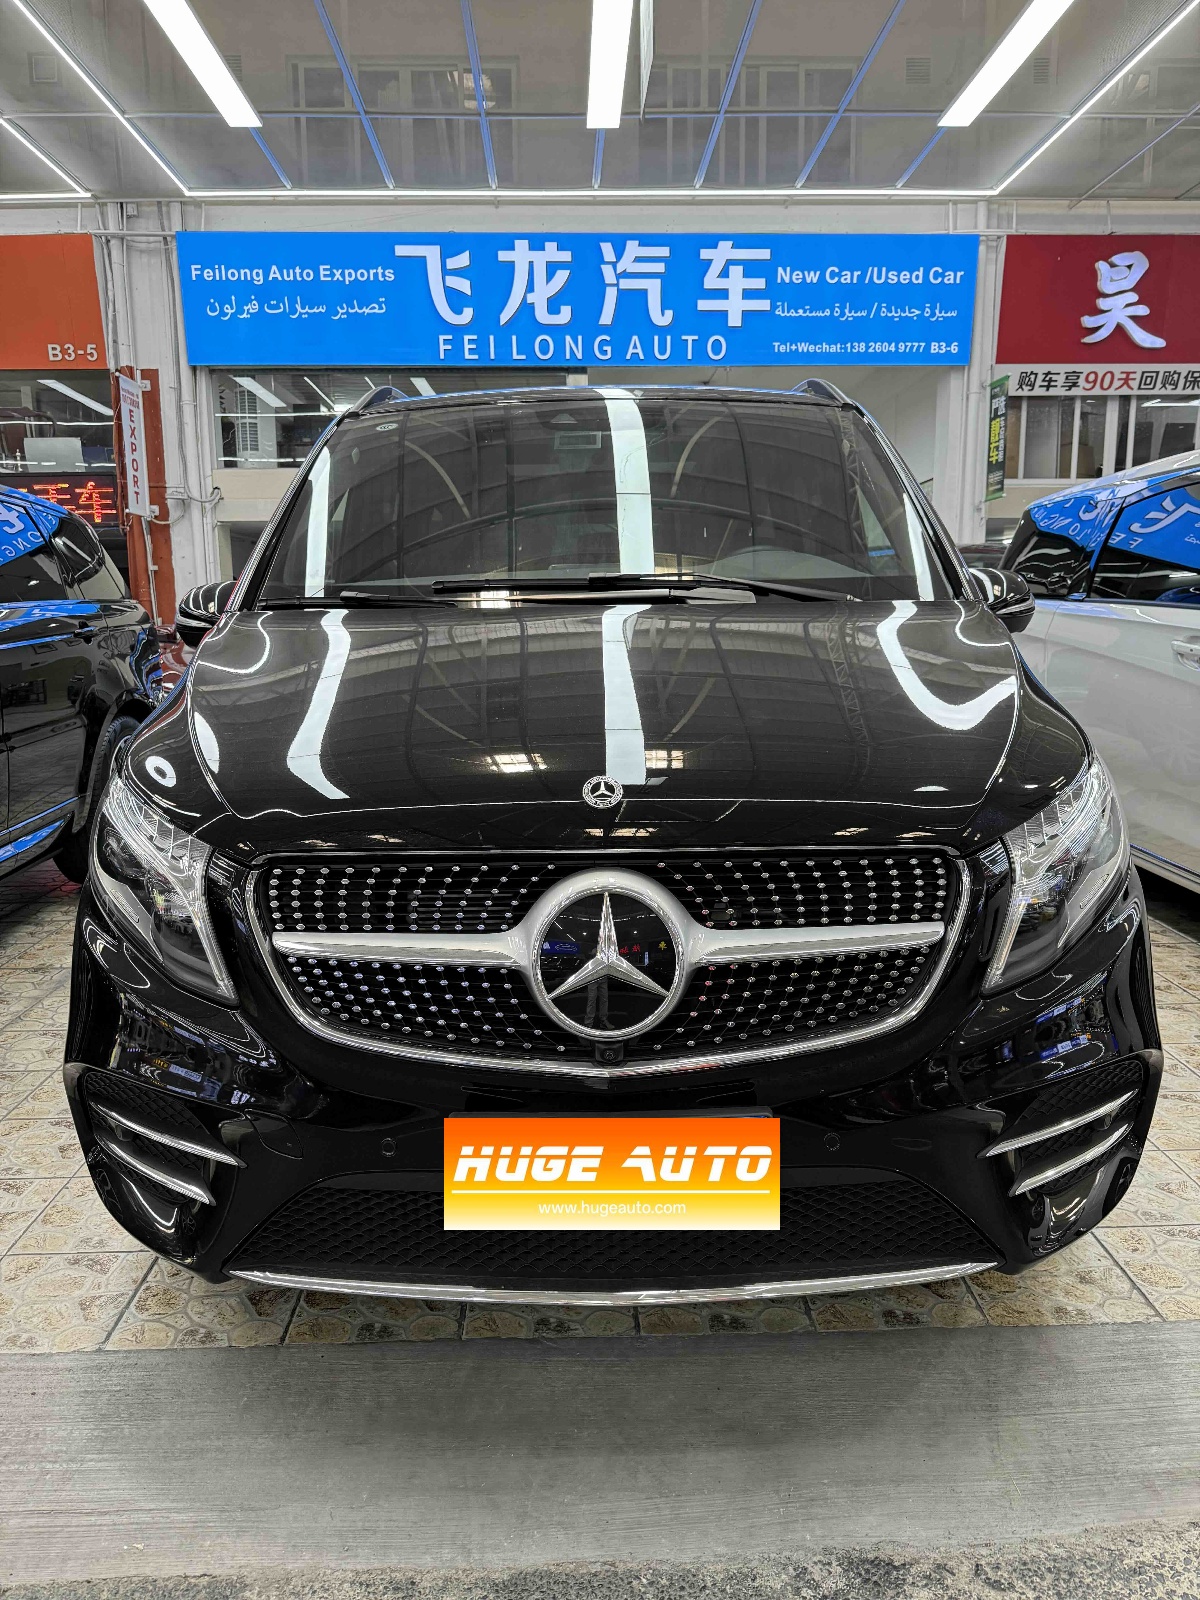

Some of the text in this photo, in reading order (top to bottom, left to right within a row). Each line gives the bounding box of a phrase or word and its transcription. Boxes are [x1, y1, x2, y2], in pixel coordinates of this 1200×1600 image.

[190, 264, 395, 285] Feilong Auto Exports
[395, 239, 771, 328] 飞龙汽车
[776, 266, 820, 284] New
[825, 266, 861, 284] Car
[929, 267, 965, 284] Car
[264, 296, 327, 319] سيارات
[331, 297, 387, 320] تصدير
[775, 302, 831, 317] مستعملة
[1080, 251, 1167, 349] 昊
[833, 302, 868, 321] سيارة
[880, 303, 922, 321] جديدة
[923, 302, 958, 321] سيارة
[47, 343, 98, 362] B3-5
[868, 342, 896, 353] 2604
[898, 342, 926, 353] 9777
[930, 342, 959, 354] B3-6
[128, 408, 140, 505] EXPORT
